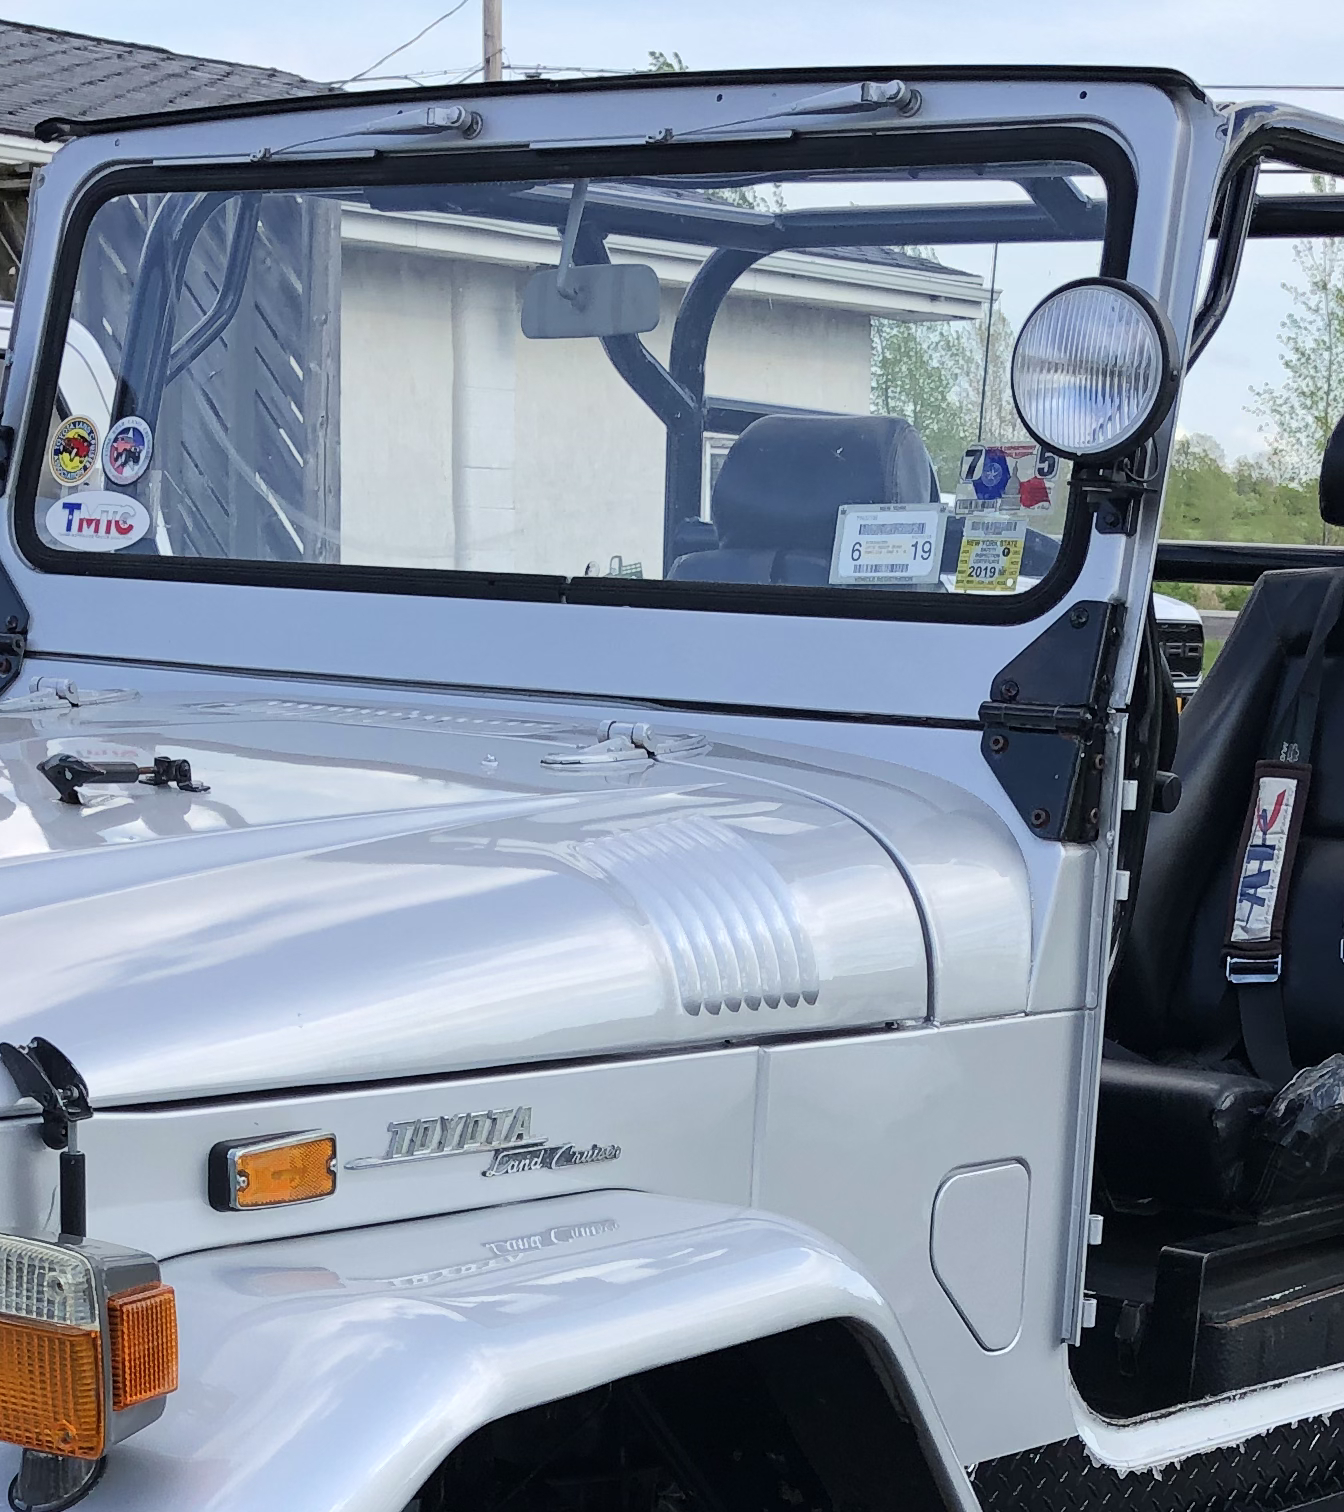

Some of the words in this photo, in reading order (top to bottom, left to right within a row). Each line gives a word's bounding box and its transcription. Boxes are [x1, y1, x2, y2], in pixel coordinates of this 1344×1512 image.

[965, 449, 984, 480] 7
[1038, 446, 1056, 477] 5
[851, 541, 862, 562] 6
[911, 540, 932, 561] 19
[967, 566, 996, 578] 2019
[385, 1106, 533, 1159] TOYOTA
[481, 1148, 544, 1177] Land
[550, 1142, 622, 1170] Cruiser
